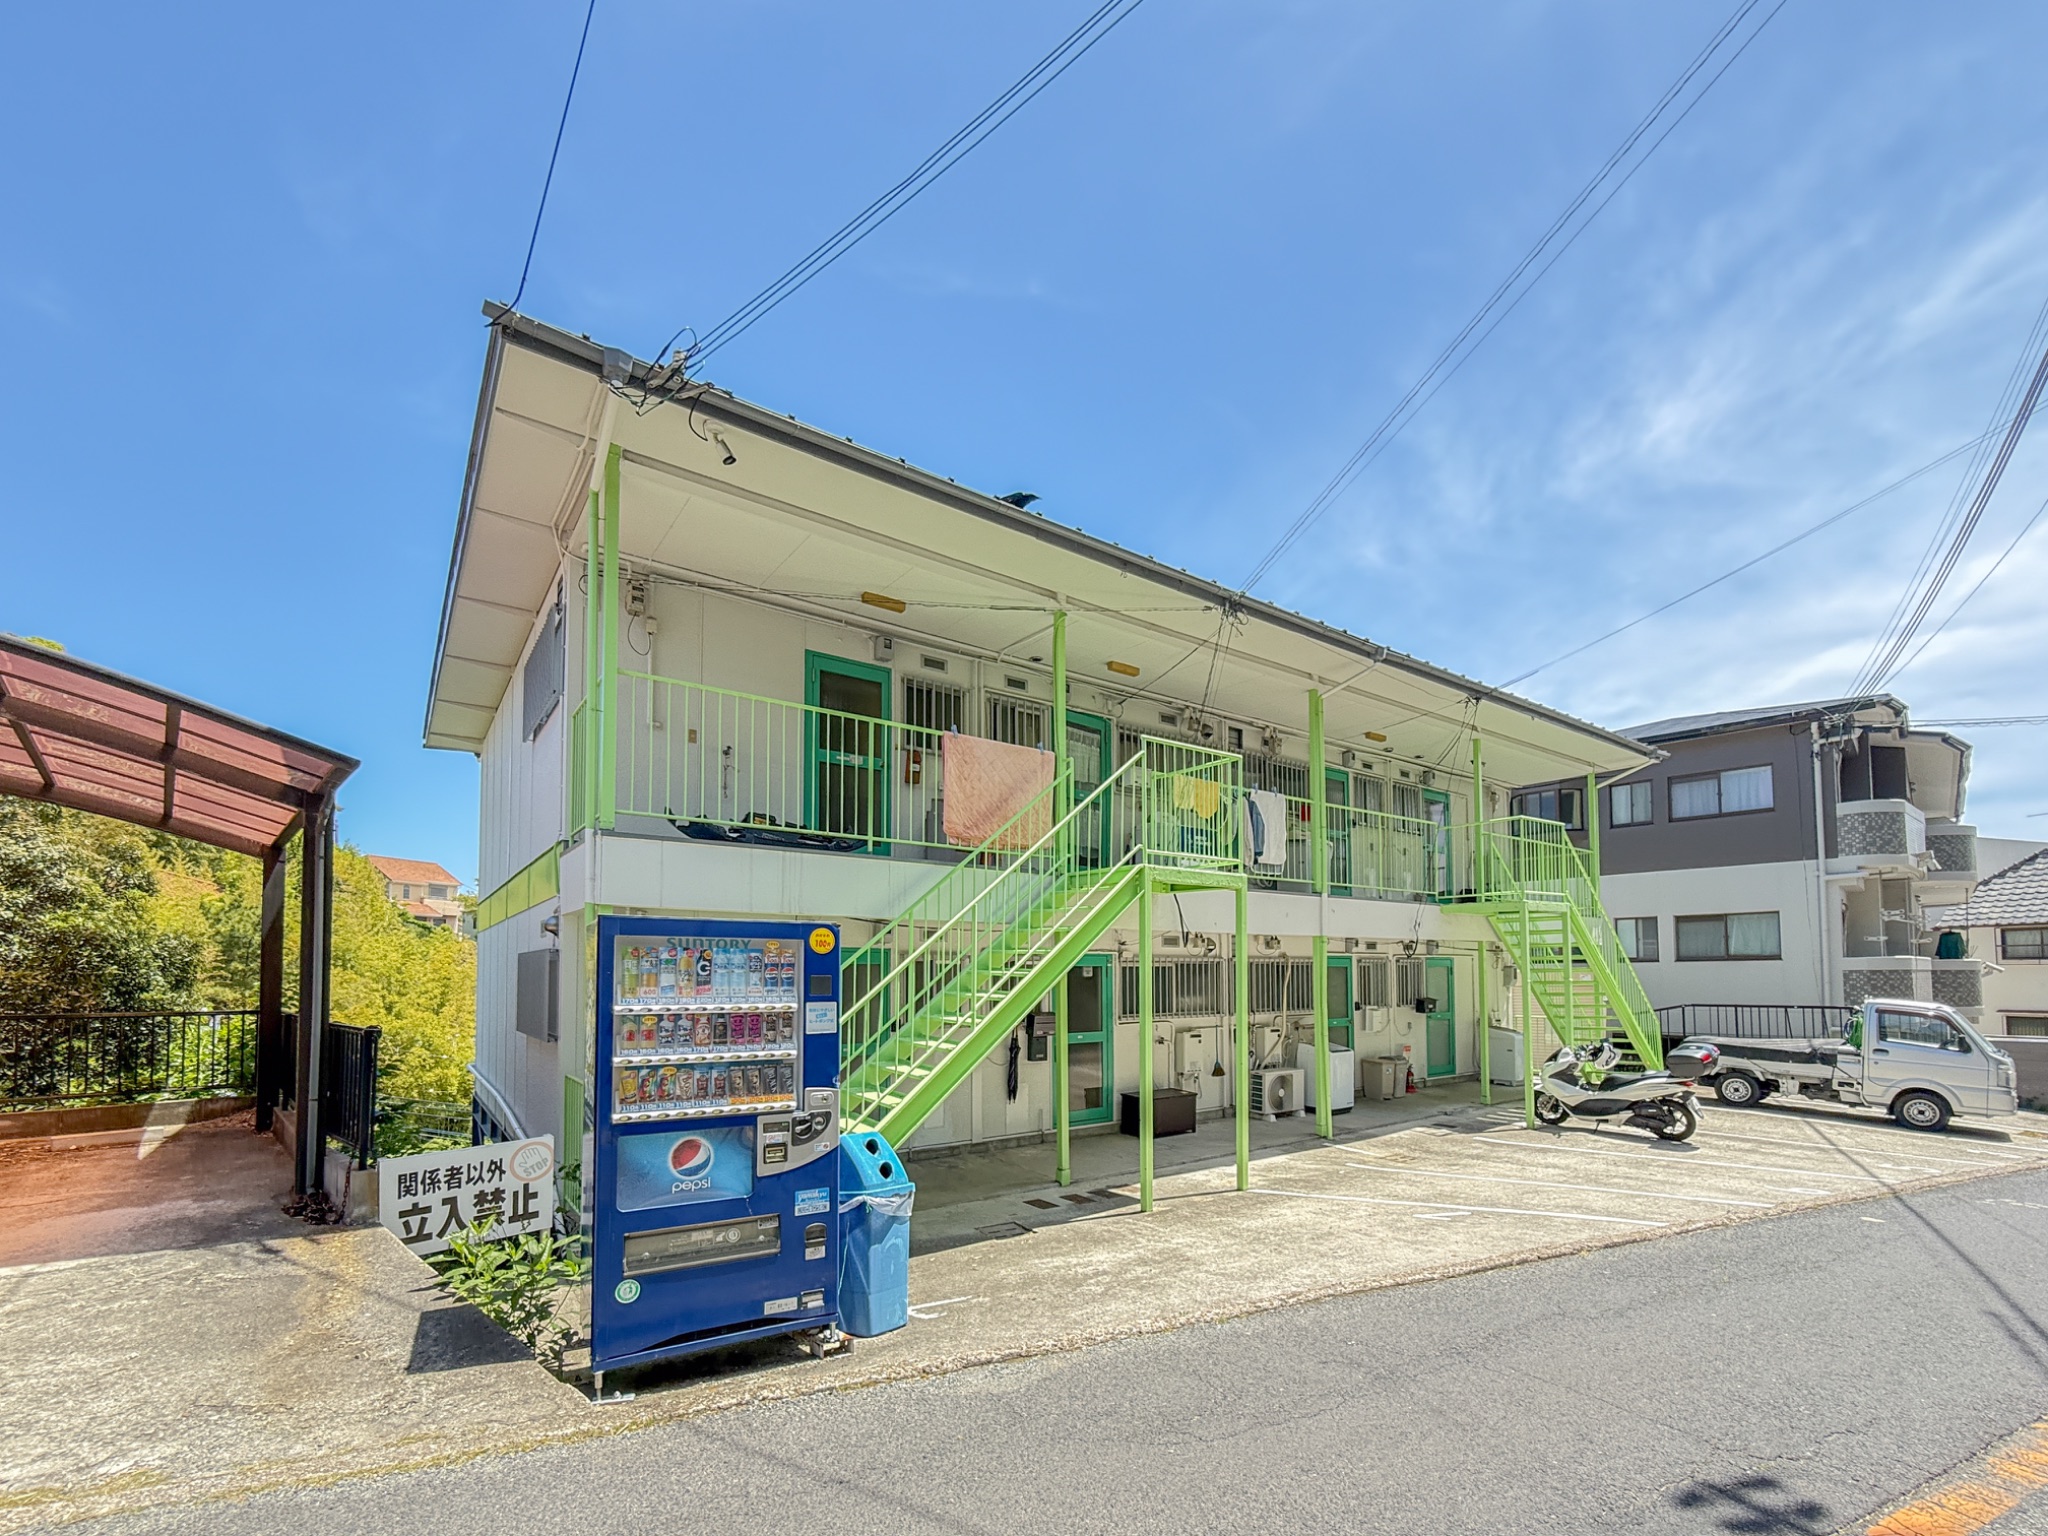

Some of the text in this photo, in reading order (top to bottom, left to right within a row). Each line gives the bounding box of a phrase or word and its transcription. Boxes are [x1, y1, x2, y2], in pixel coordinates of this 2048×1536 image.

[666, 937, 752, 950] SUNTORY
[522, 1157, 549, 1177] STOP
[397, 1158, 507, 1200] 関係者以外
[671, 1176, 711, 1194] pepsi
[398, 1182, 540, 1245] 立入禁止
